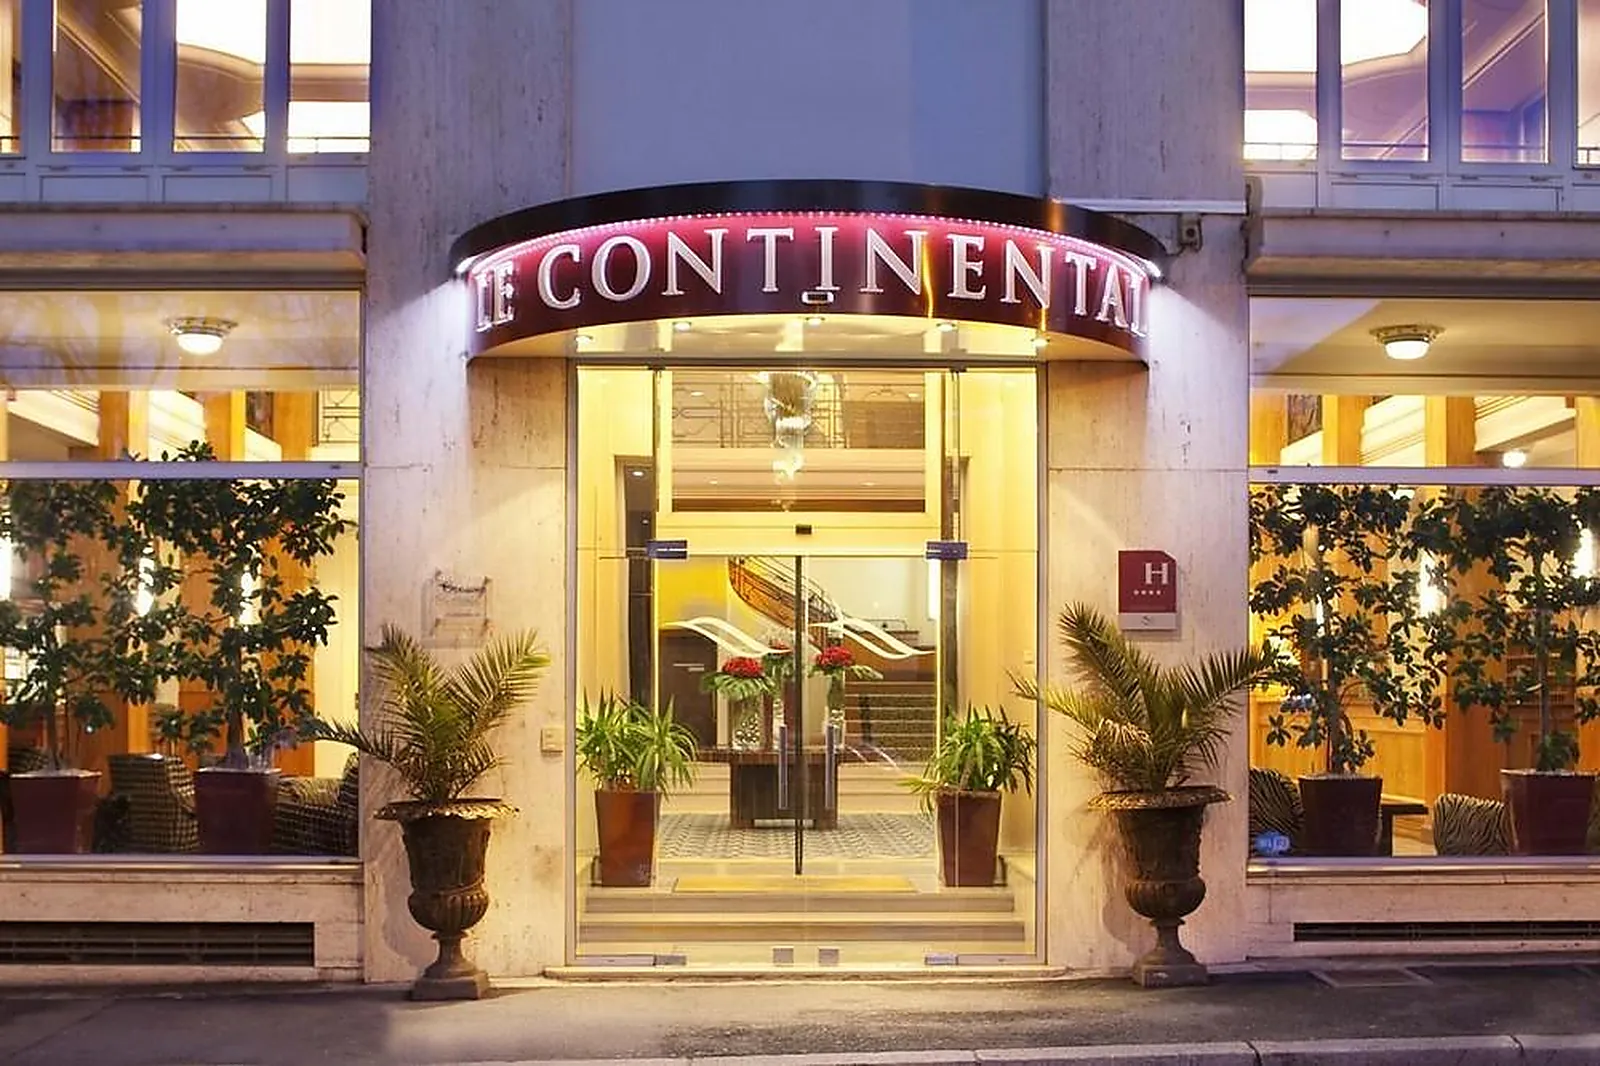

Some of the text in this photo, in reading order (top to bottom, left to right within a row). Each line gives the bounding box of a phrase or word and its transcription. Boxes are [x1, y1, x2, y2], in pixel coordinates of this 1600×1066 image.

[475, 226, 1147, 337] LE CONTINENTAL
[1145, 562, 1168, 585] H
